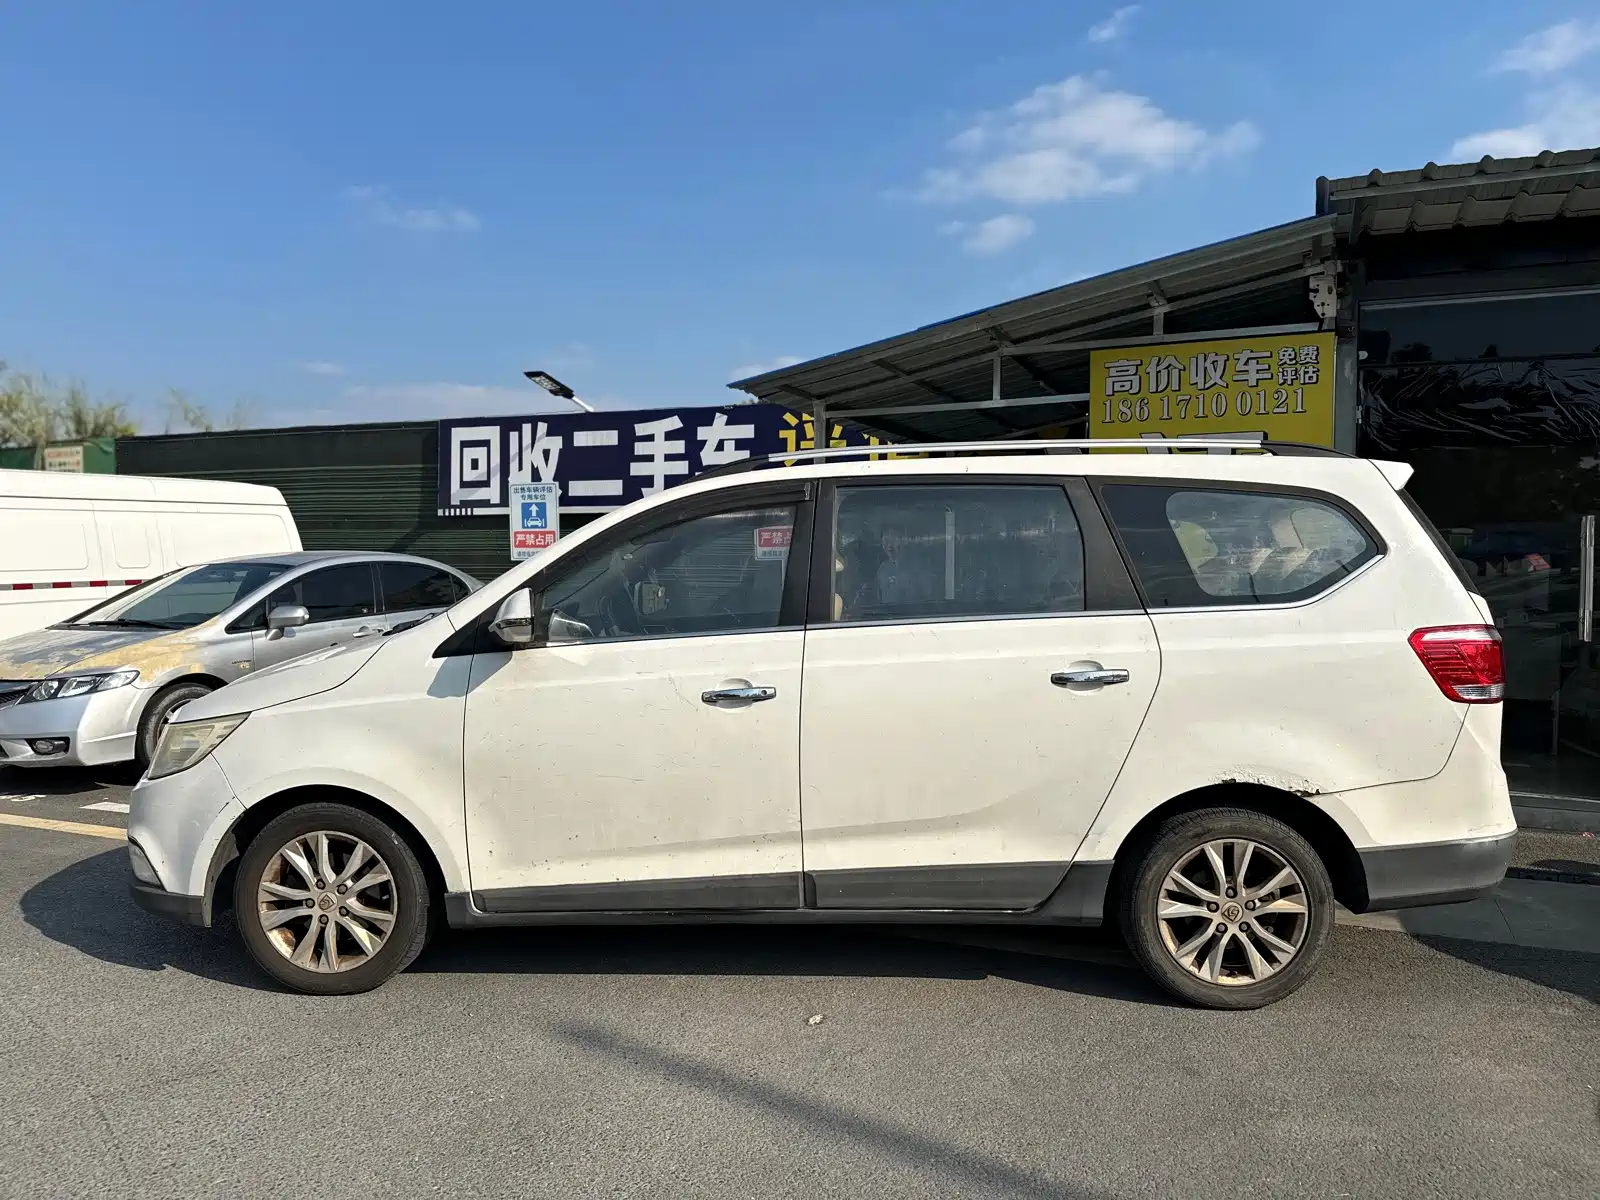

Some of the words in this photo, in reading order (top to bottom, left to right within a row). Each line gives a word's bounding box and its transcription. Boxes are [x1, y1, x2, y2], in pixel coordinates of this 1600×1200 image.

[1277, 345, 1319, 366] 免费
[1104, 350, 1273, 396] 高价收车
[1277, 366, 1319, 386] 评估
[1102, 398, 1149, 423] 186
[1160, 391, 1227, 420] 1710
[1236, 387, 1307, 416] 0121
[513, 486, 553, 494] 出售车辆评估
[520, 493, 546, 501] 专用车位
[515, 533, 554, 546] 严禁占用
